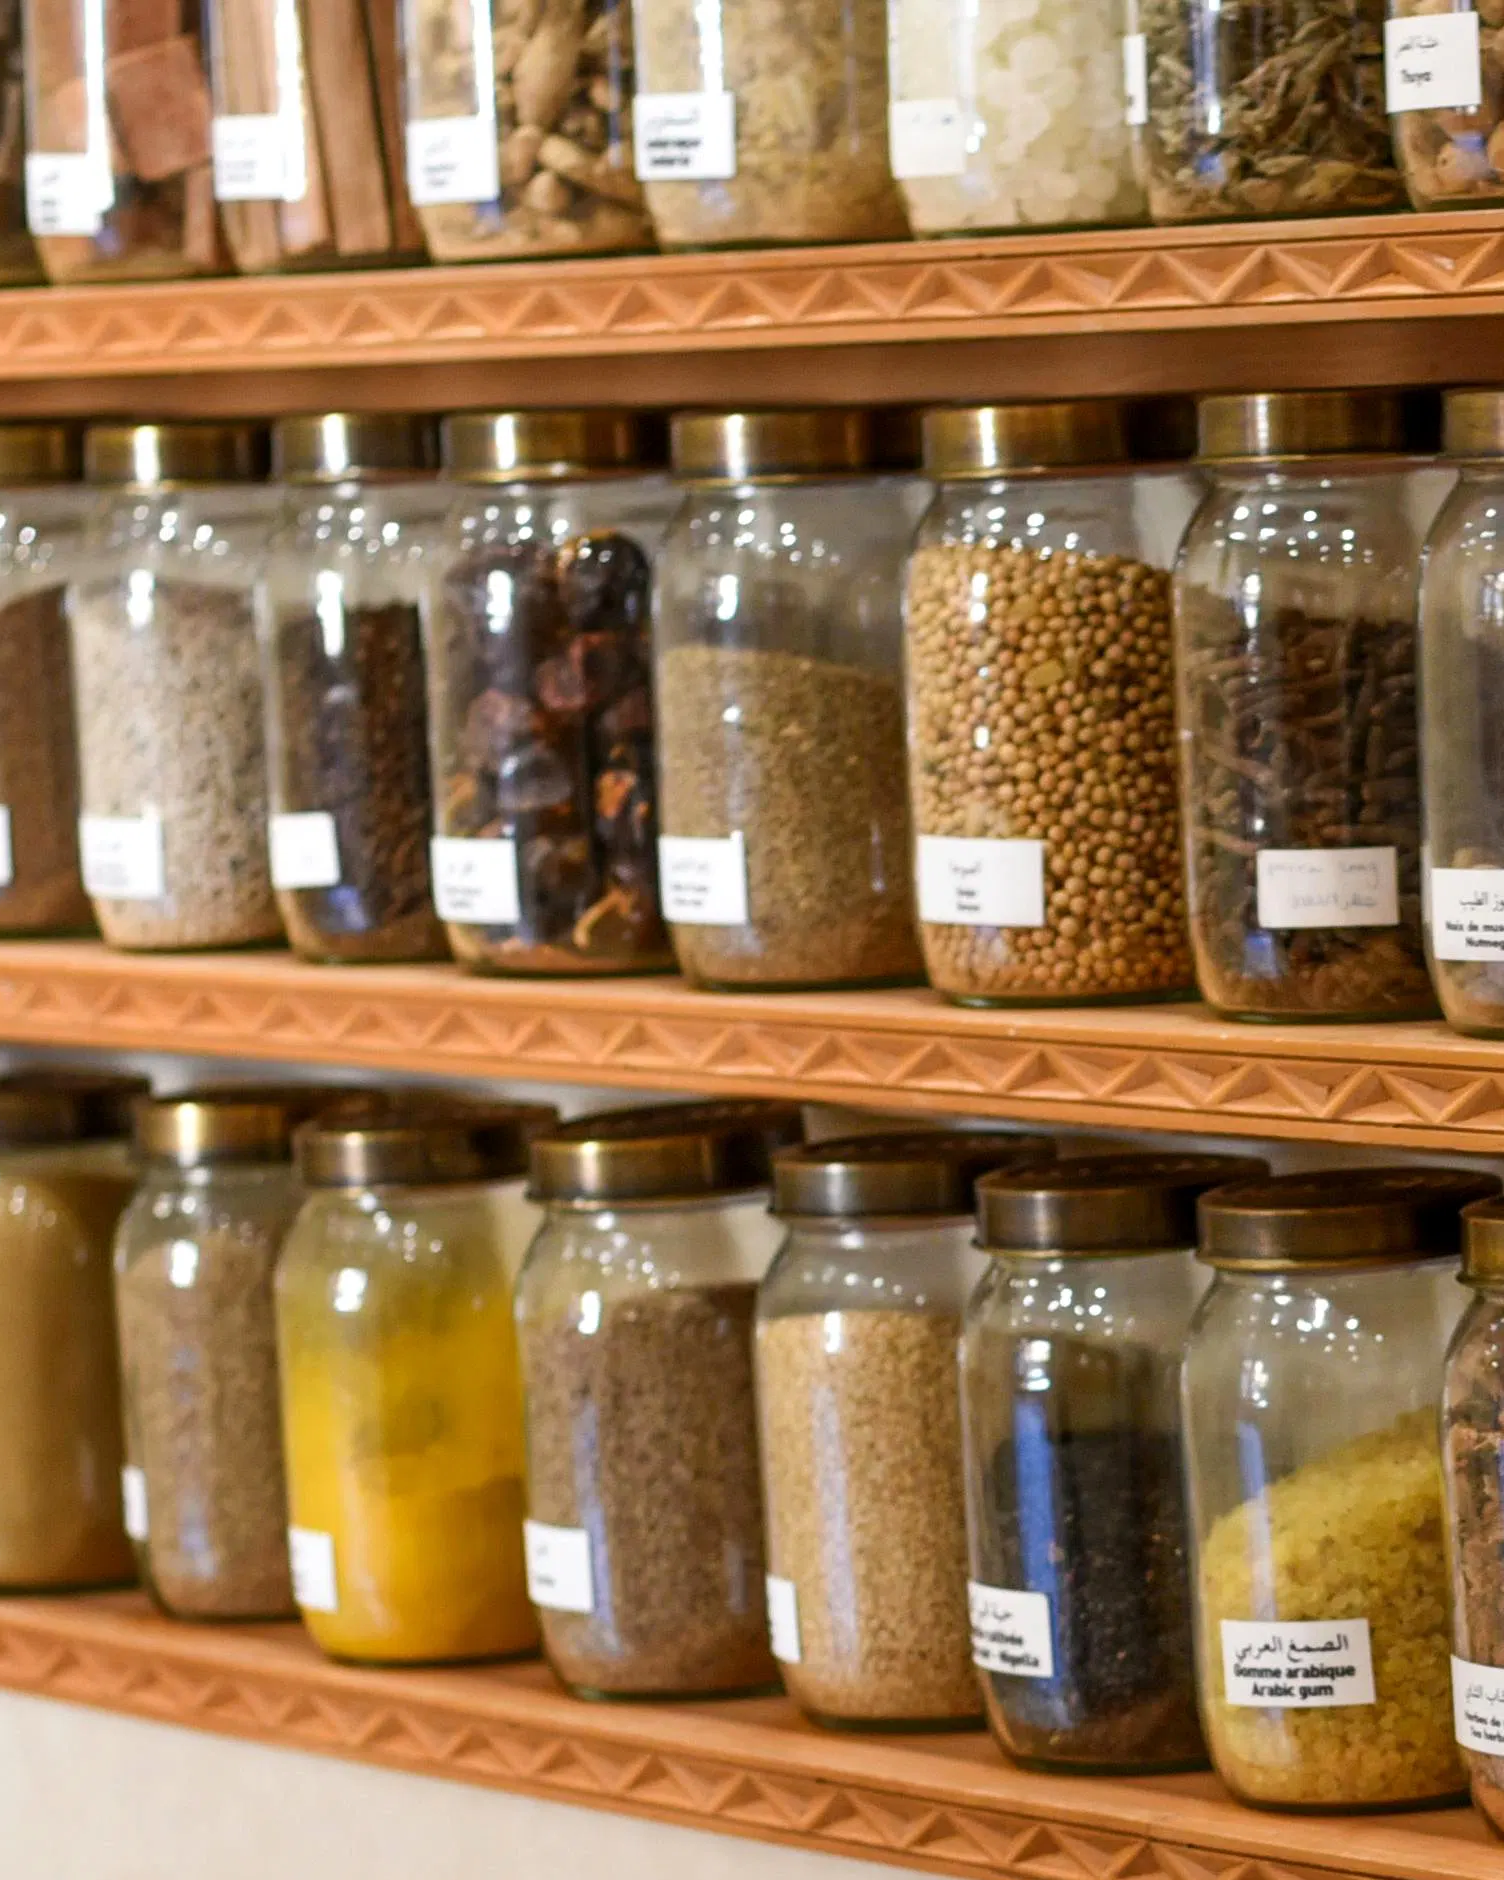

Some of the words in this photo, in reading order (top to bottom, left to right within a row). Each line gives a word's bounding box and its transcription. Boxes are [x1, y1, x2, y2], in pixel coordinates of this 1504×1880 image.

[1468, 921, 1478, 933] de
[1236, 1636, 1283, 1663] العربي
[1286, 1633, 1349, 1662] الصمغ
[1286, 1663, 1355, 1681] arabique
[1252, 1684, 1294, 1698] Arabic
[1298, 1685, 1334, 1700] gum
